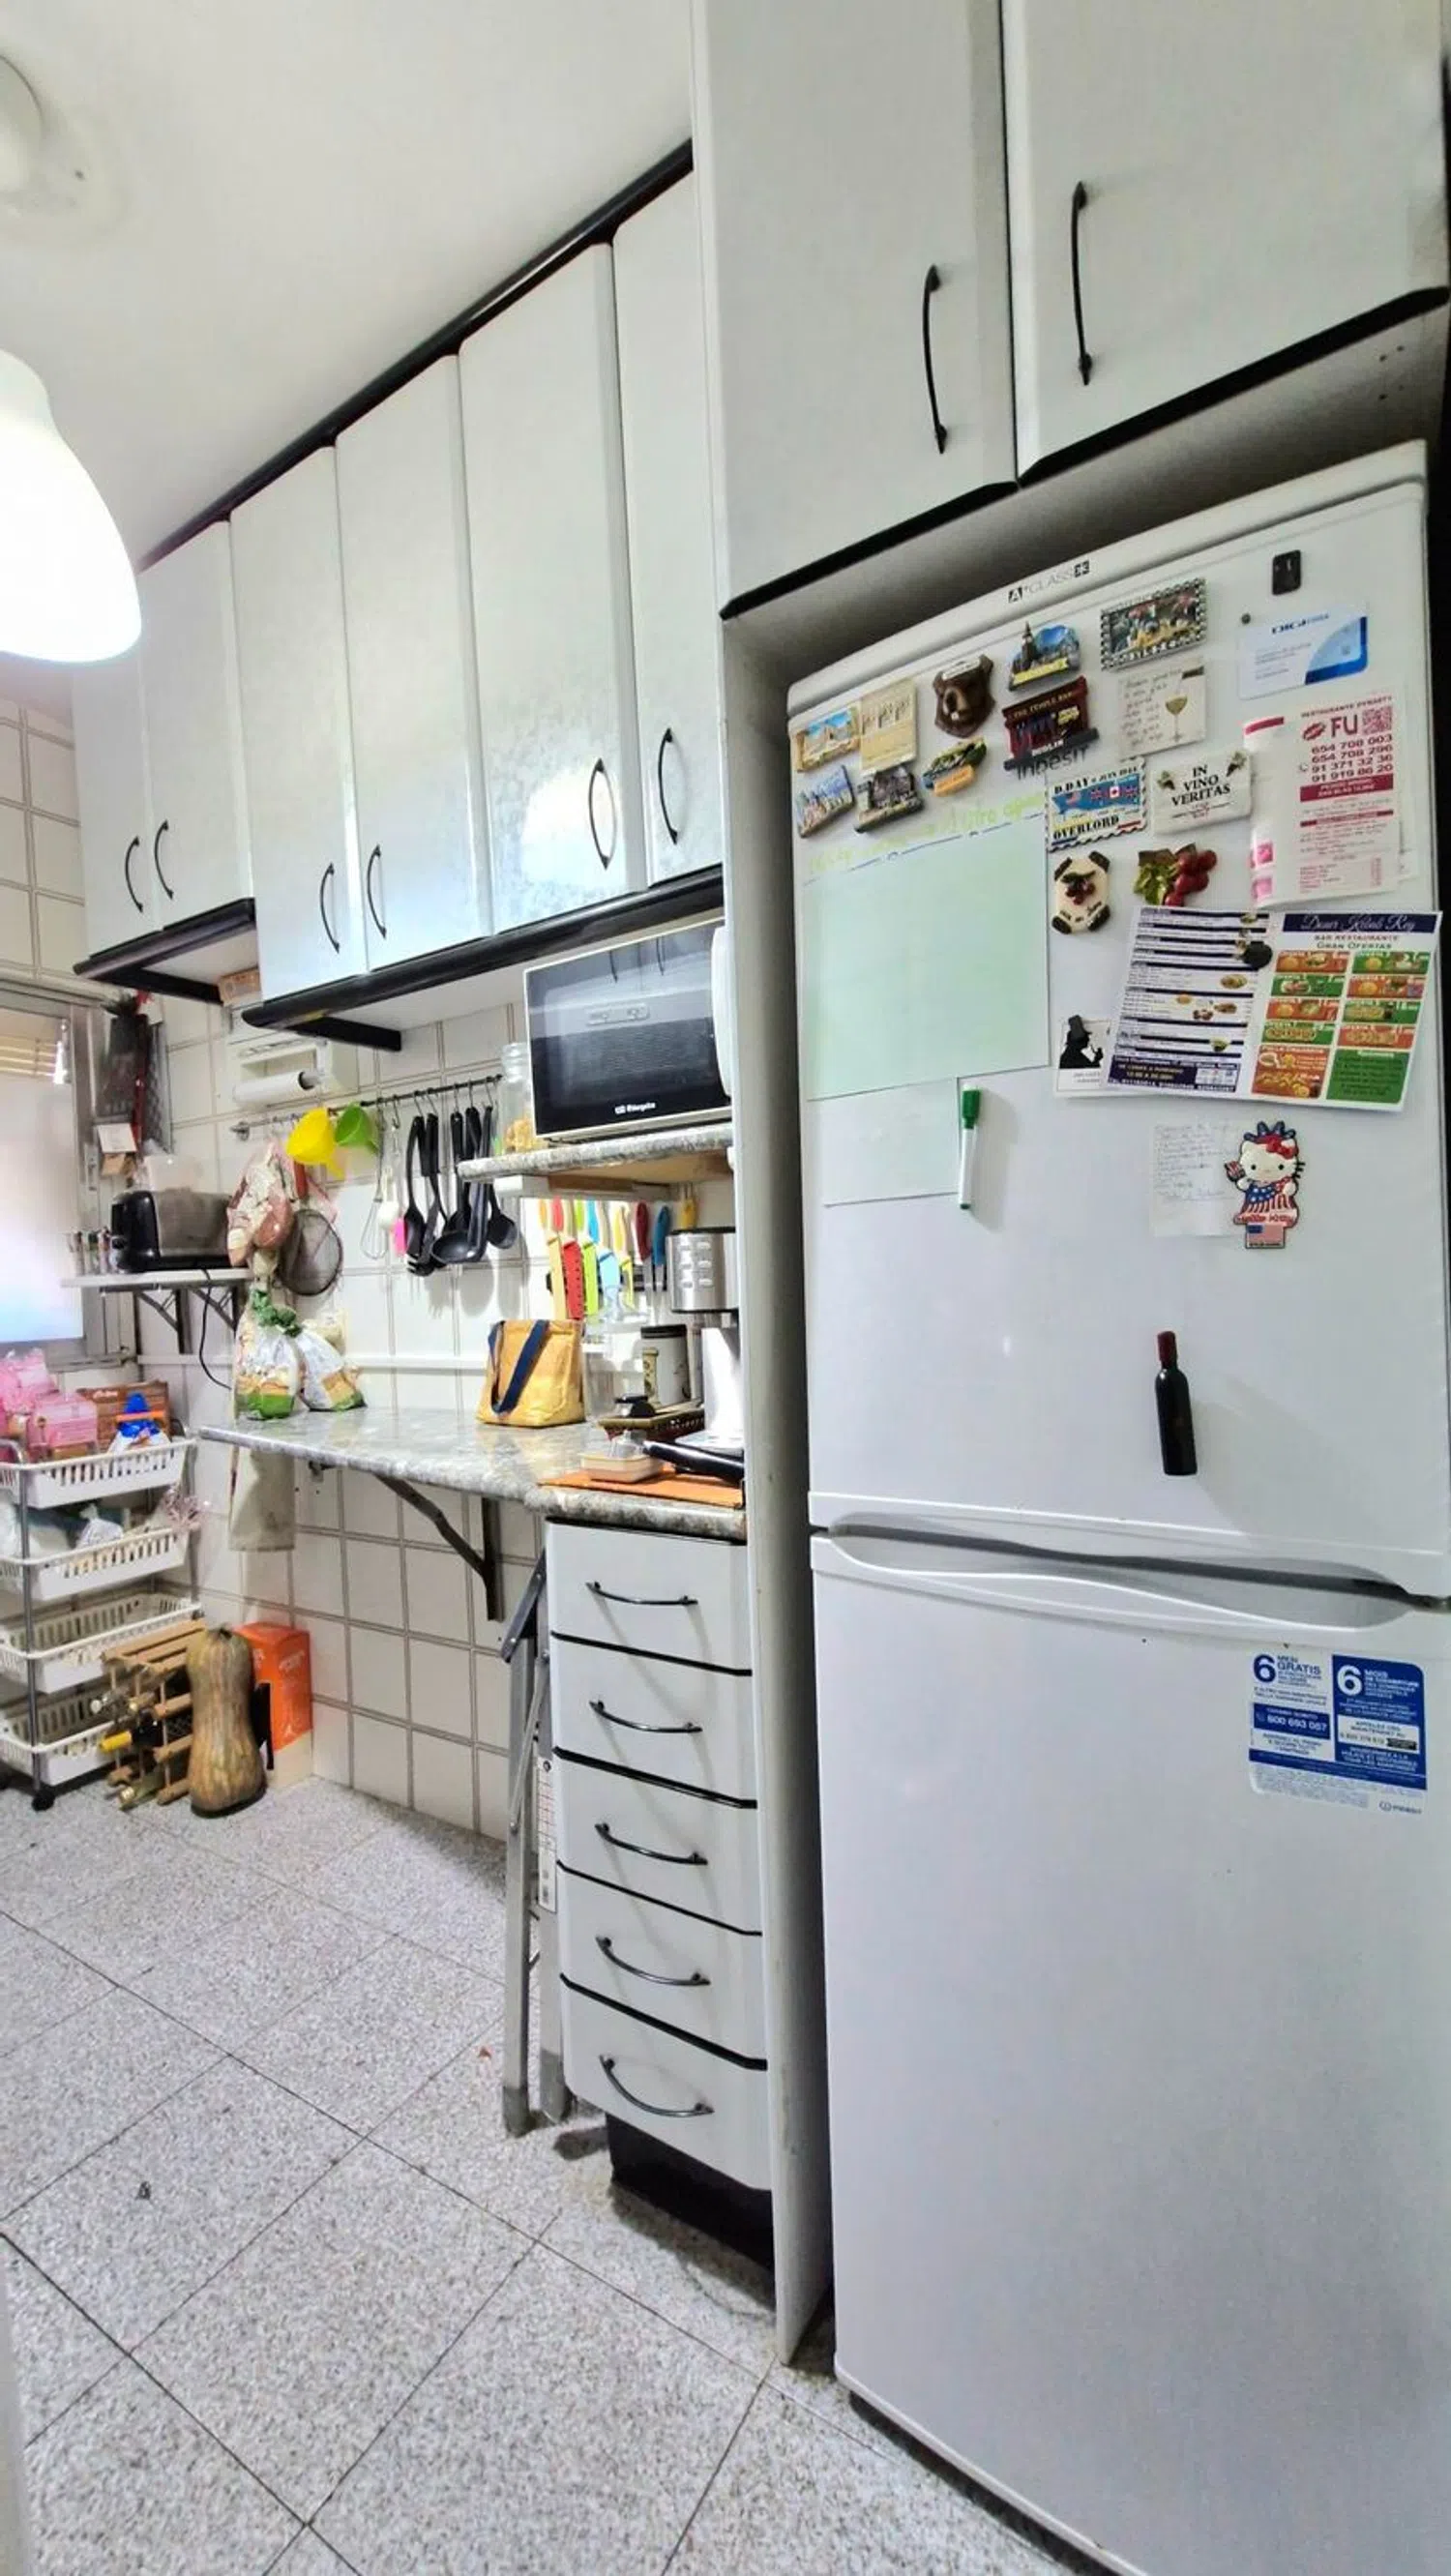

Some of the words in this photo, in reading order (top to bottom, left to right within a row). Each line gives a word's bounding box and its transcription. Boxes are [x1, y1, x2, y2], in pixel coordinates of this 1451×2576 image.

[1331, 714, 1358, 737] FU
[1193, 764, 1208, 778] IN
[1183, 774, 1219, 792] VINO
[1171, 783, 1231, 807] VERITAS
[1053, 814, 1119, 840] OVERLORD
[1253, 1653, 1276, 1683] 6
[1277, 1662, 1321, 1675] GRATIS
[1337, 1664, 1363, 1696] 6
[1267, 1714, 1287, 1725] 800
